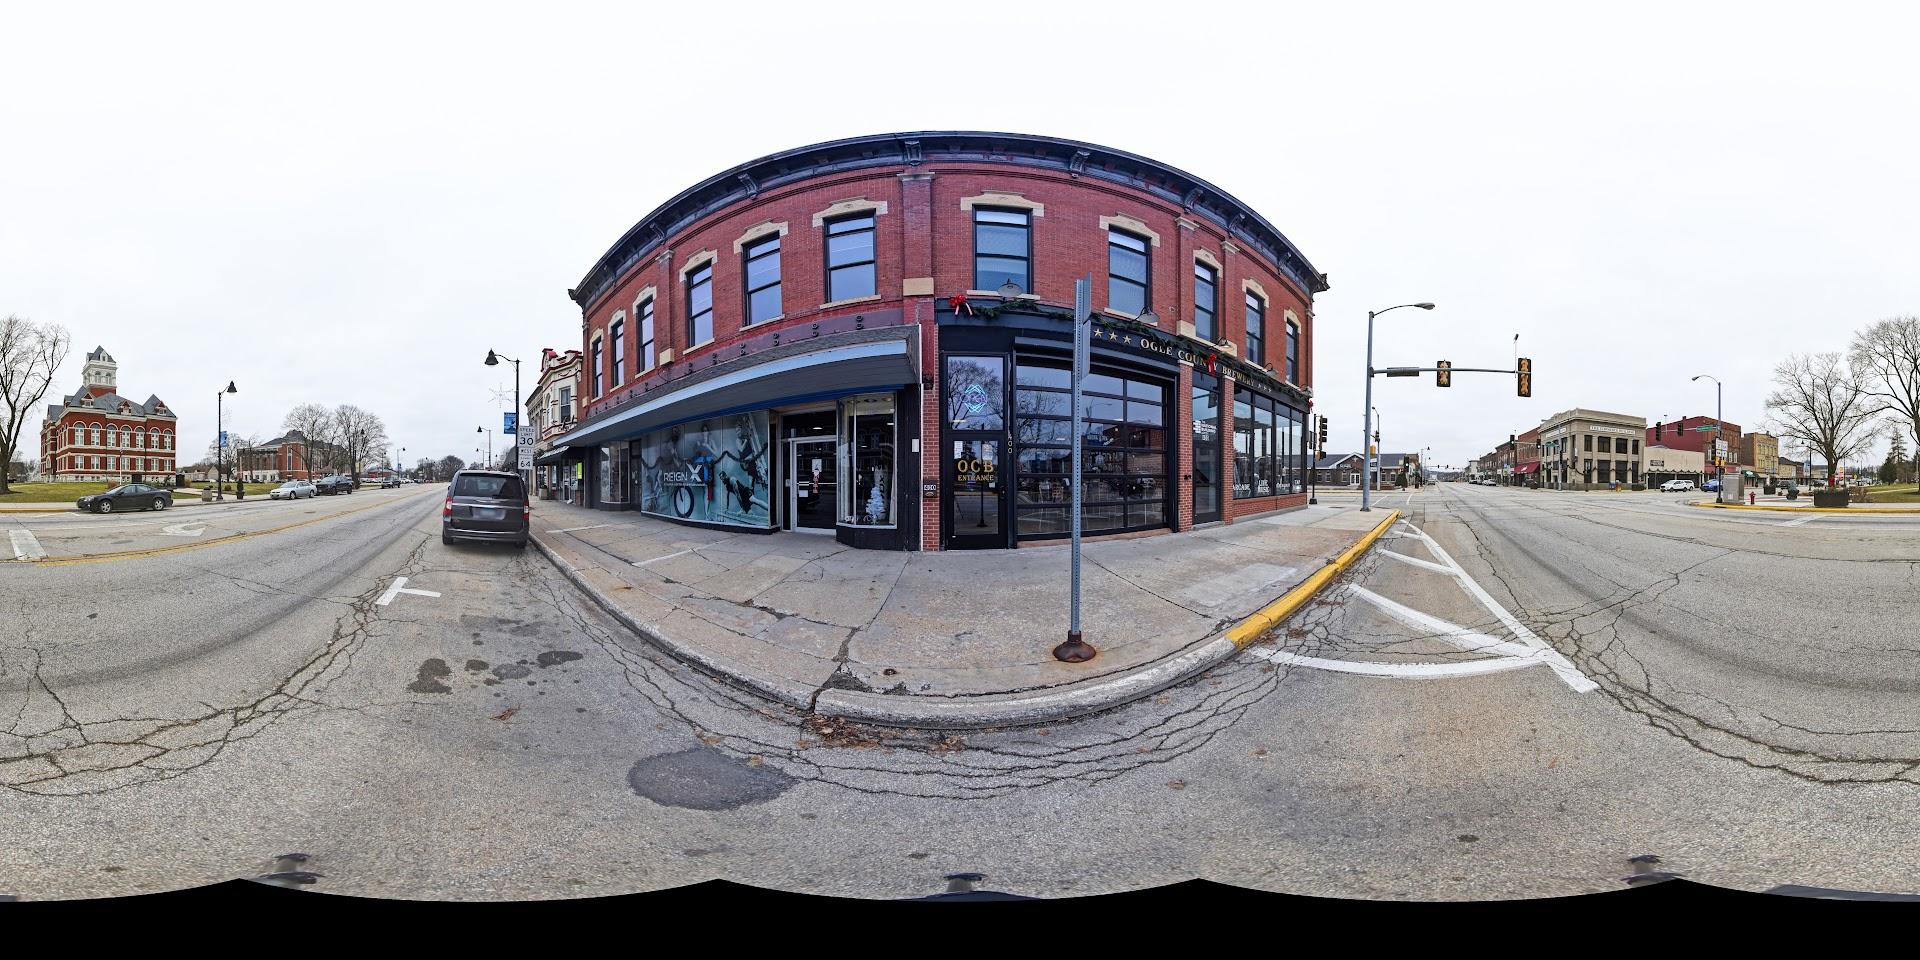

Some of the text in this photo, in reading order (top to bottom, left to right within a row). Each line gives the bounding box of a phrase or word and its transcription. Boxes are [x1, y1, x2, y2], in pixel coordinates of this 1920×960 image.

[1140, 338, 1255, 387] OGLE COUNY BREWERY
[520, 437, 533, 445] 30
[957, 459, 994, 473] OCB
[663, 471, 688, 481] REIGN
[957, 474, 994, 482] ENTRANCE
